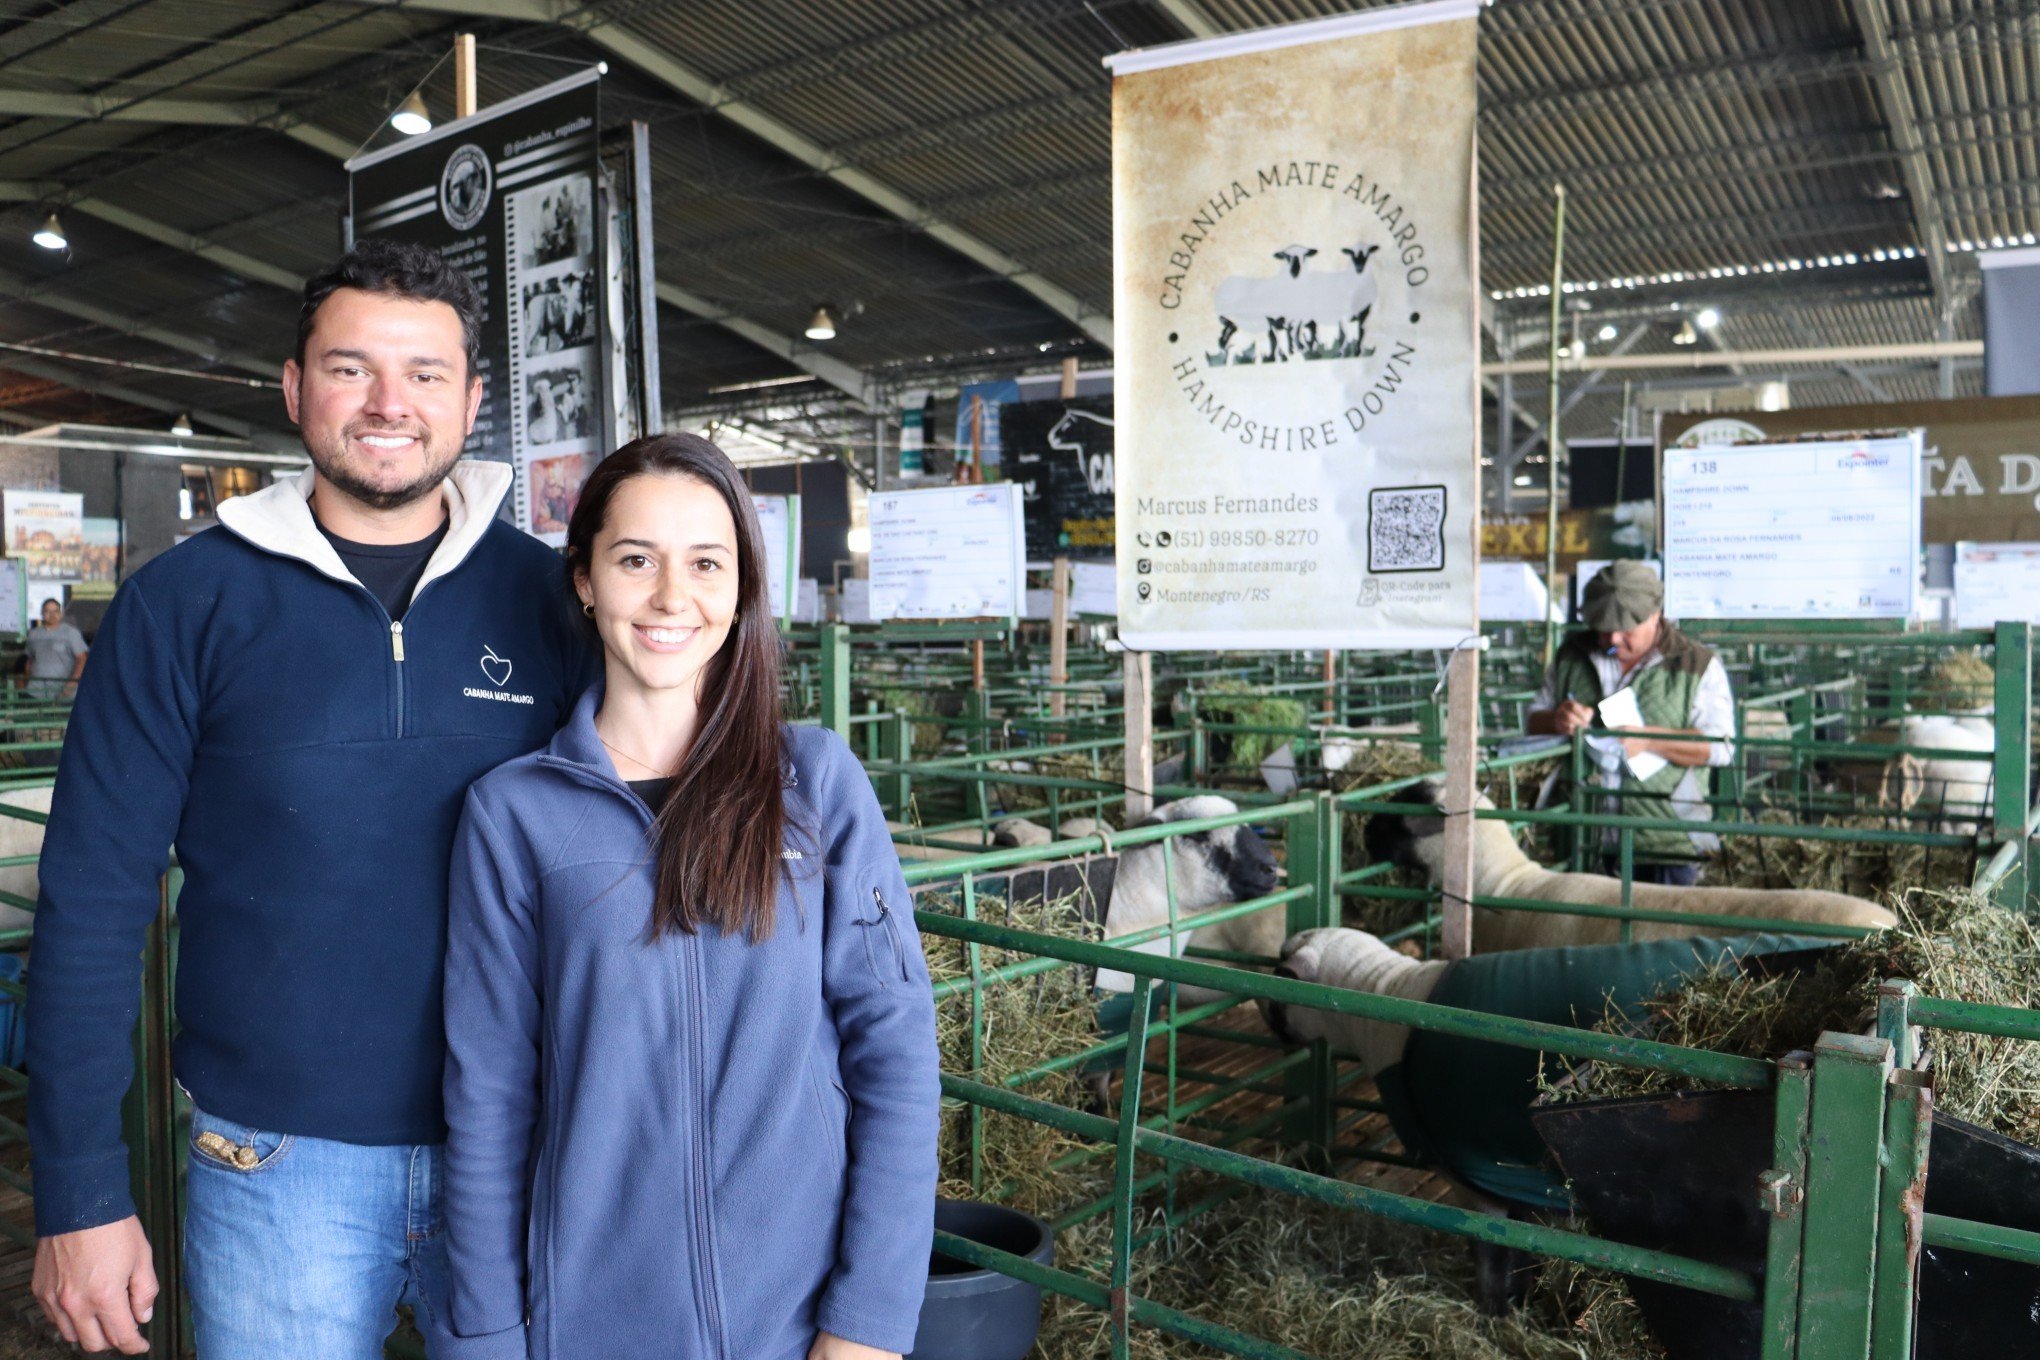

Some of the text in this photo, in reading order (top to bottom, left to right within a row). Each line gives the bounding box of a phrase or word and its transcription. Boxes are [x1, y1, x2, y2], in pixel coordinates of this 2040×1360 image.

[1159, 160, 1430, 310] CABANHA MATE AMARGO
[1172, 340, 1416, 452] HAMPSHIRE DOWN
[1691, 461, 1718, 475] 138
[1136, 491, 1320, 516] Marcus Fernandes
[1174, 528, 1320, 549] (51) 99850-8270
[1153, 558, 1318, 576] @cabanhamateamargo
[1156, 587, 1271, 606] Montenegro/RS
[463, 686, 535, 705] CABANHA MATE AMARGO
